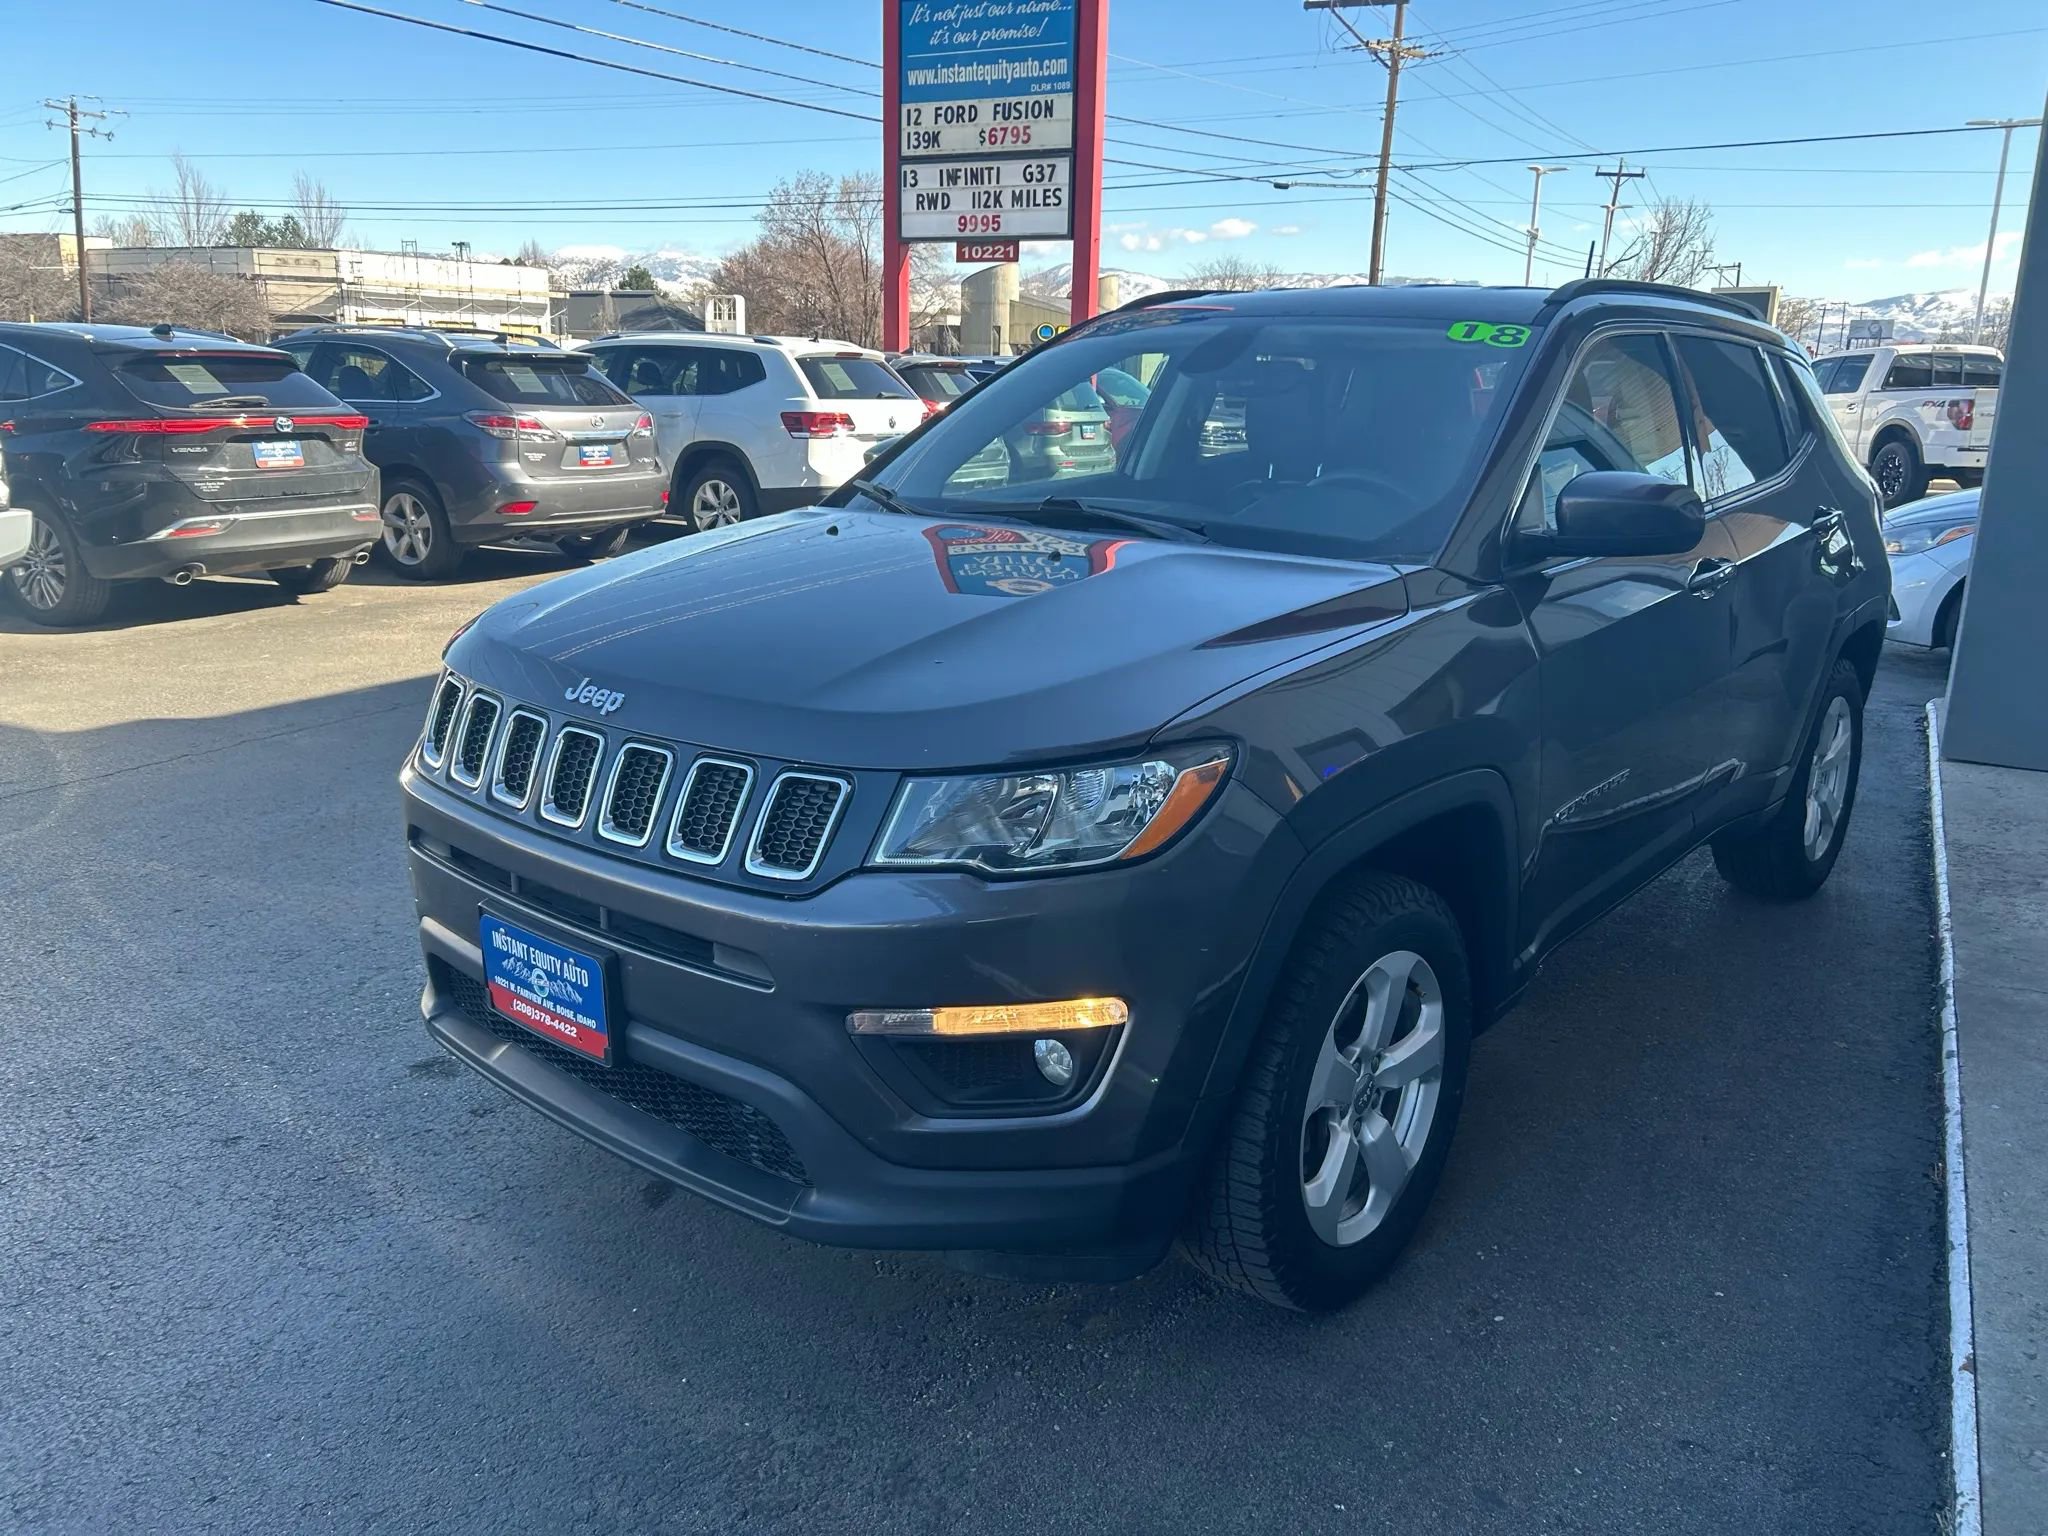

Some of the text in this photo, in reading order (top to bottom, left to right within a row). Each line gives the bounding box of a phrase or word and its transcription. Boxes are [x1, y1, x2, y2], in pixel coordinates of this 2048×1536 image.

[908, 3, 930, 26] It's
[933, 4, 957, 22] not
[952, 1, 985, 28] just
[988, 1, 1014, 17] our
[929, 17, 1049, 48] it's our promise!
[907, 57, 1068, 86] www.instantequityauto.com
[1031, 82, 1052, 92] DLR#
[906, 99, 1055, 127] 12 FORD FUSION
[906, 125, 1032, 150] 139K $6795
[903, 163, 1057, 188] 13 INFINITI G37
[916, 187, 1062, 211] RWD 112K MILES
[957, 214, 1001, 233] 9995
[960, 245, 1015, 259] 10221
[1461, 323, 1526, 346] 18
[1922, 400, 1947, 409] FX4
[564, 677, 625, 716] Jeep
[492, 931, 589, 987] INSTANT EQUITY AUTO
[509, 981, 517, 993] W.
[516, 985, 543, 1005] FAIRVIEW
[542, 998, 556, 1013] AVE.
[556, 1004, 576, 1023] BOISE,
[576, 1013, 597, 1029] IDAHO
[512, 998, 578, 1037] (208)378-4422
